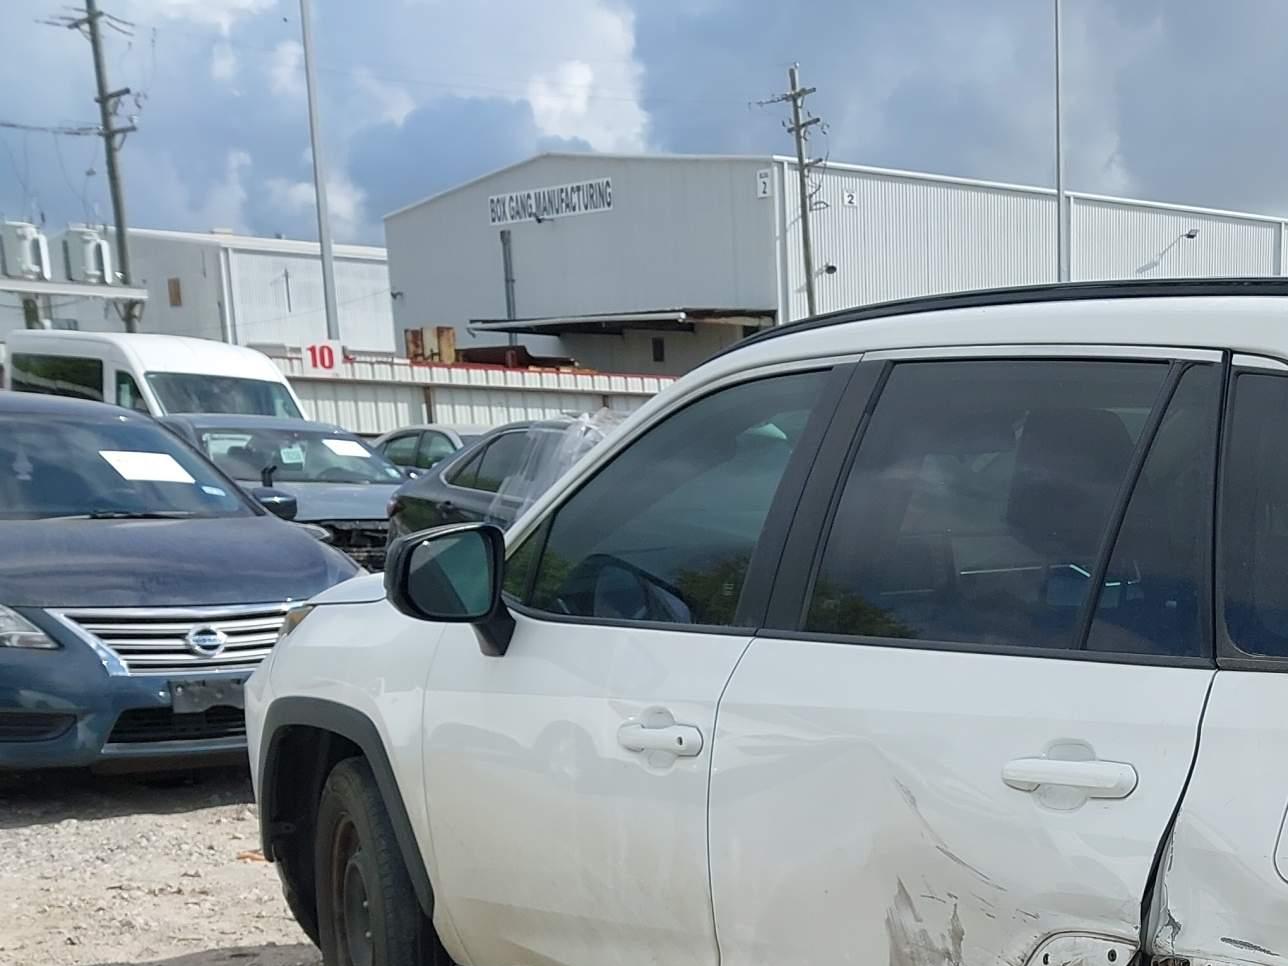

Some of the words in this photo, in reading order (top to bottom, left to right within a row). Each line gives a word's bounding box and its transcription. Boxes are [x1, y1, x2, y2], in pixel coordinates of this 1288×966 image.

[490, 197, 508, 222] BOX
[509, 192, 532, 220] GANG
[534, 180, 612, 217] MANUFACTURING
[847, 193, 855, 205] 2
[306, 345, 335, 370] 10
